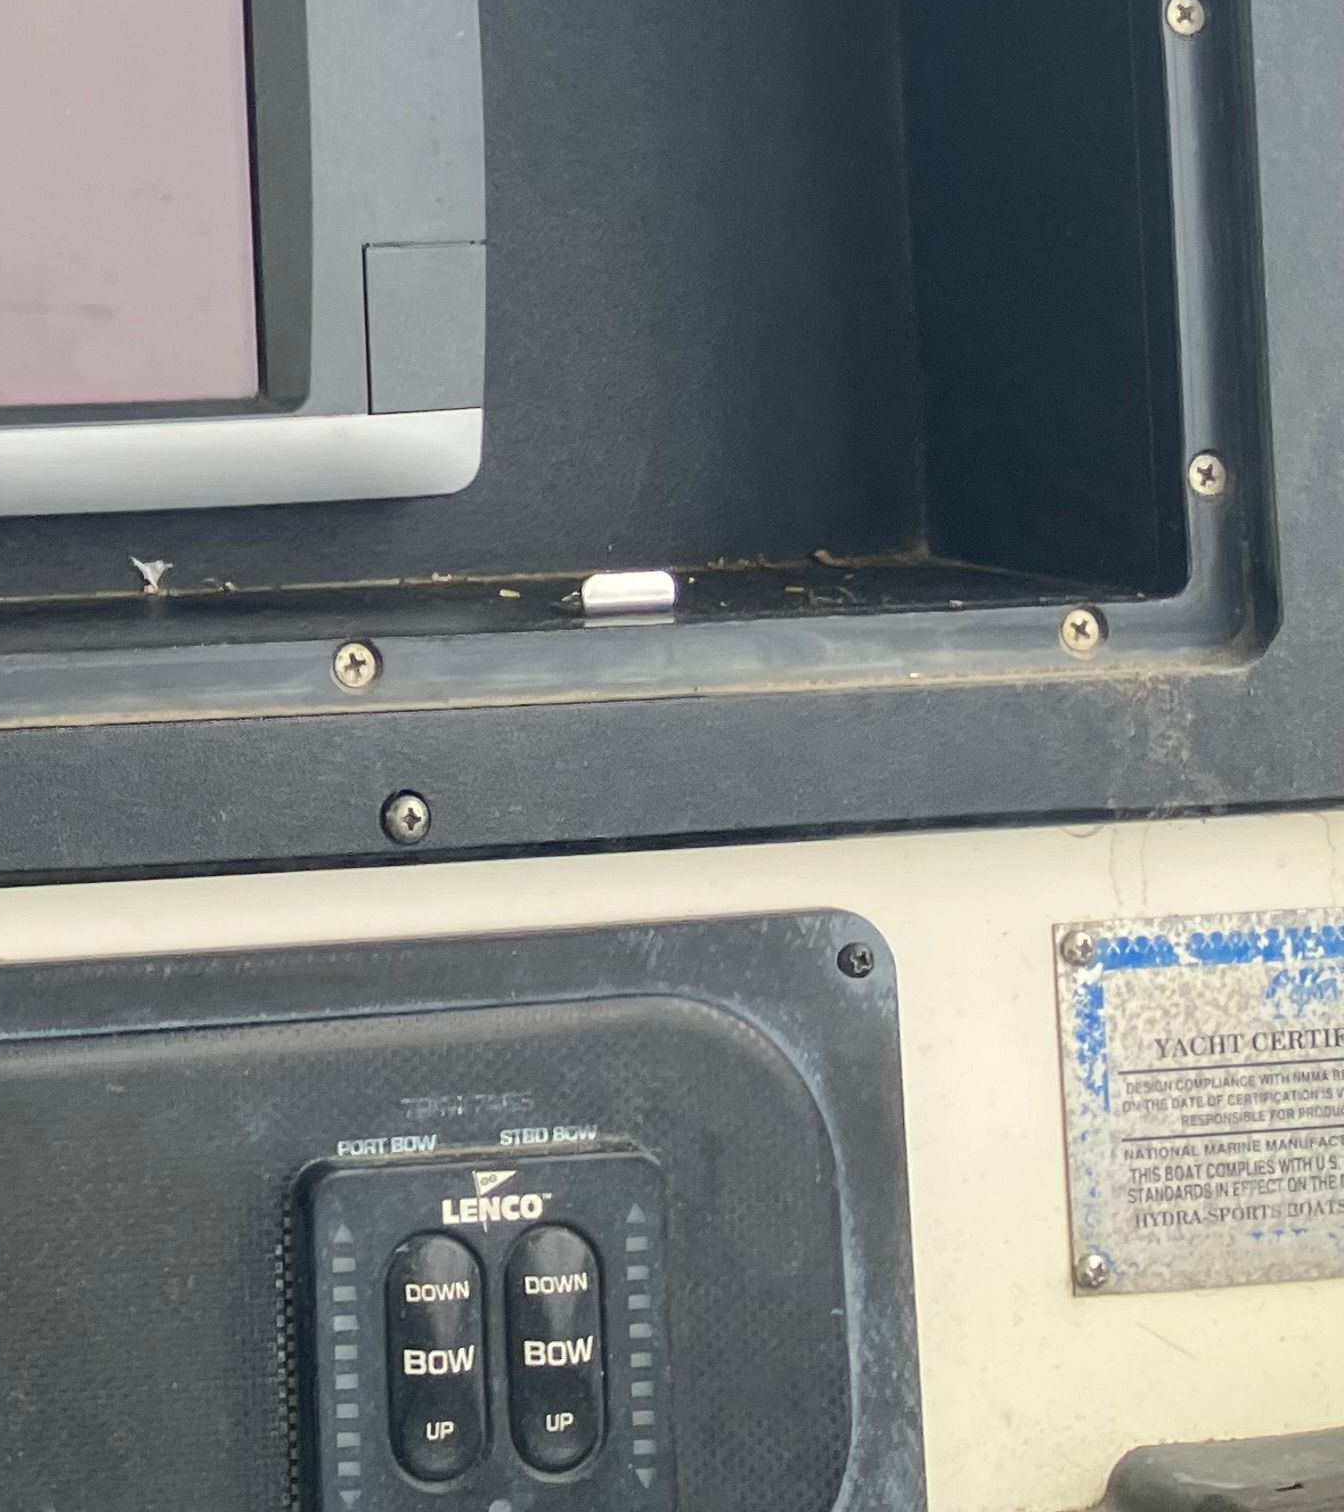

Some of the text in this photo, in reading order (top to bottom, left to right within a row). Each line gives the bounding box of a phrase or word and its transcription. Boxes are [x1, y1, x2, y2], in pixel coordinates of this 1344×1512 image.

[1153, 1033, 1243, 1059] YACHT
[1125, 1078, 1172, 1096] DESIGN
[1175, 1073, 1256, 1092] COMPLIANCE
[1259, 1072, 1289, 1086] WITH
[1143, 1097, 1168, 1112] THE
[1171, 1094, 1204, 1110] DATE
[1227, 1088, 1318, 1106] CERTIFICATION
[1181, 1110, 1266, 1128] RESPONSIBLE
[1269, 1107, 1295, 1121] FOR
[337, 1134, 437, 1157] PORT BOW
[500, 1123, 599, 1146] STBD BOW
[1123, 1144, 1199, 1161] NATIONAL
[1204, 1140, 1261, 1156] MARINE
[1130, 1166, 1161, 1185] THIS
[1164, 1163, 1202, 1182] BOAT
[1206, 1159, 1276, 1180] COMPLIES
[1278, 1156, 1312, 1175] WITH
[1127, 1182, 1212, 1204] STANDARDS
[1215, 1181, 1229, 1198] IN
[1233, 1177, 1284, 1197] EFFECT
[1287, 1175, 1308, 1193] ON
[1311, 1172, 1336, 1191] THE
[442, 1193, 543, 1225] LENCO
[405, 1280, 470, 1303] DOWN
[524, 1272, 588, 1295] DOWN
[403, 1344, 475, 1376] BOW
[523, 1335, 594, 1367] BOW
[426, 1421, 455, 1441] UP
[545, 1412, 574, 1432] UP
